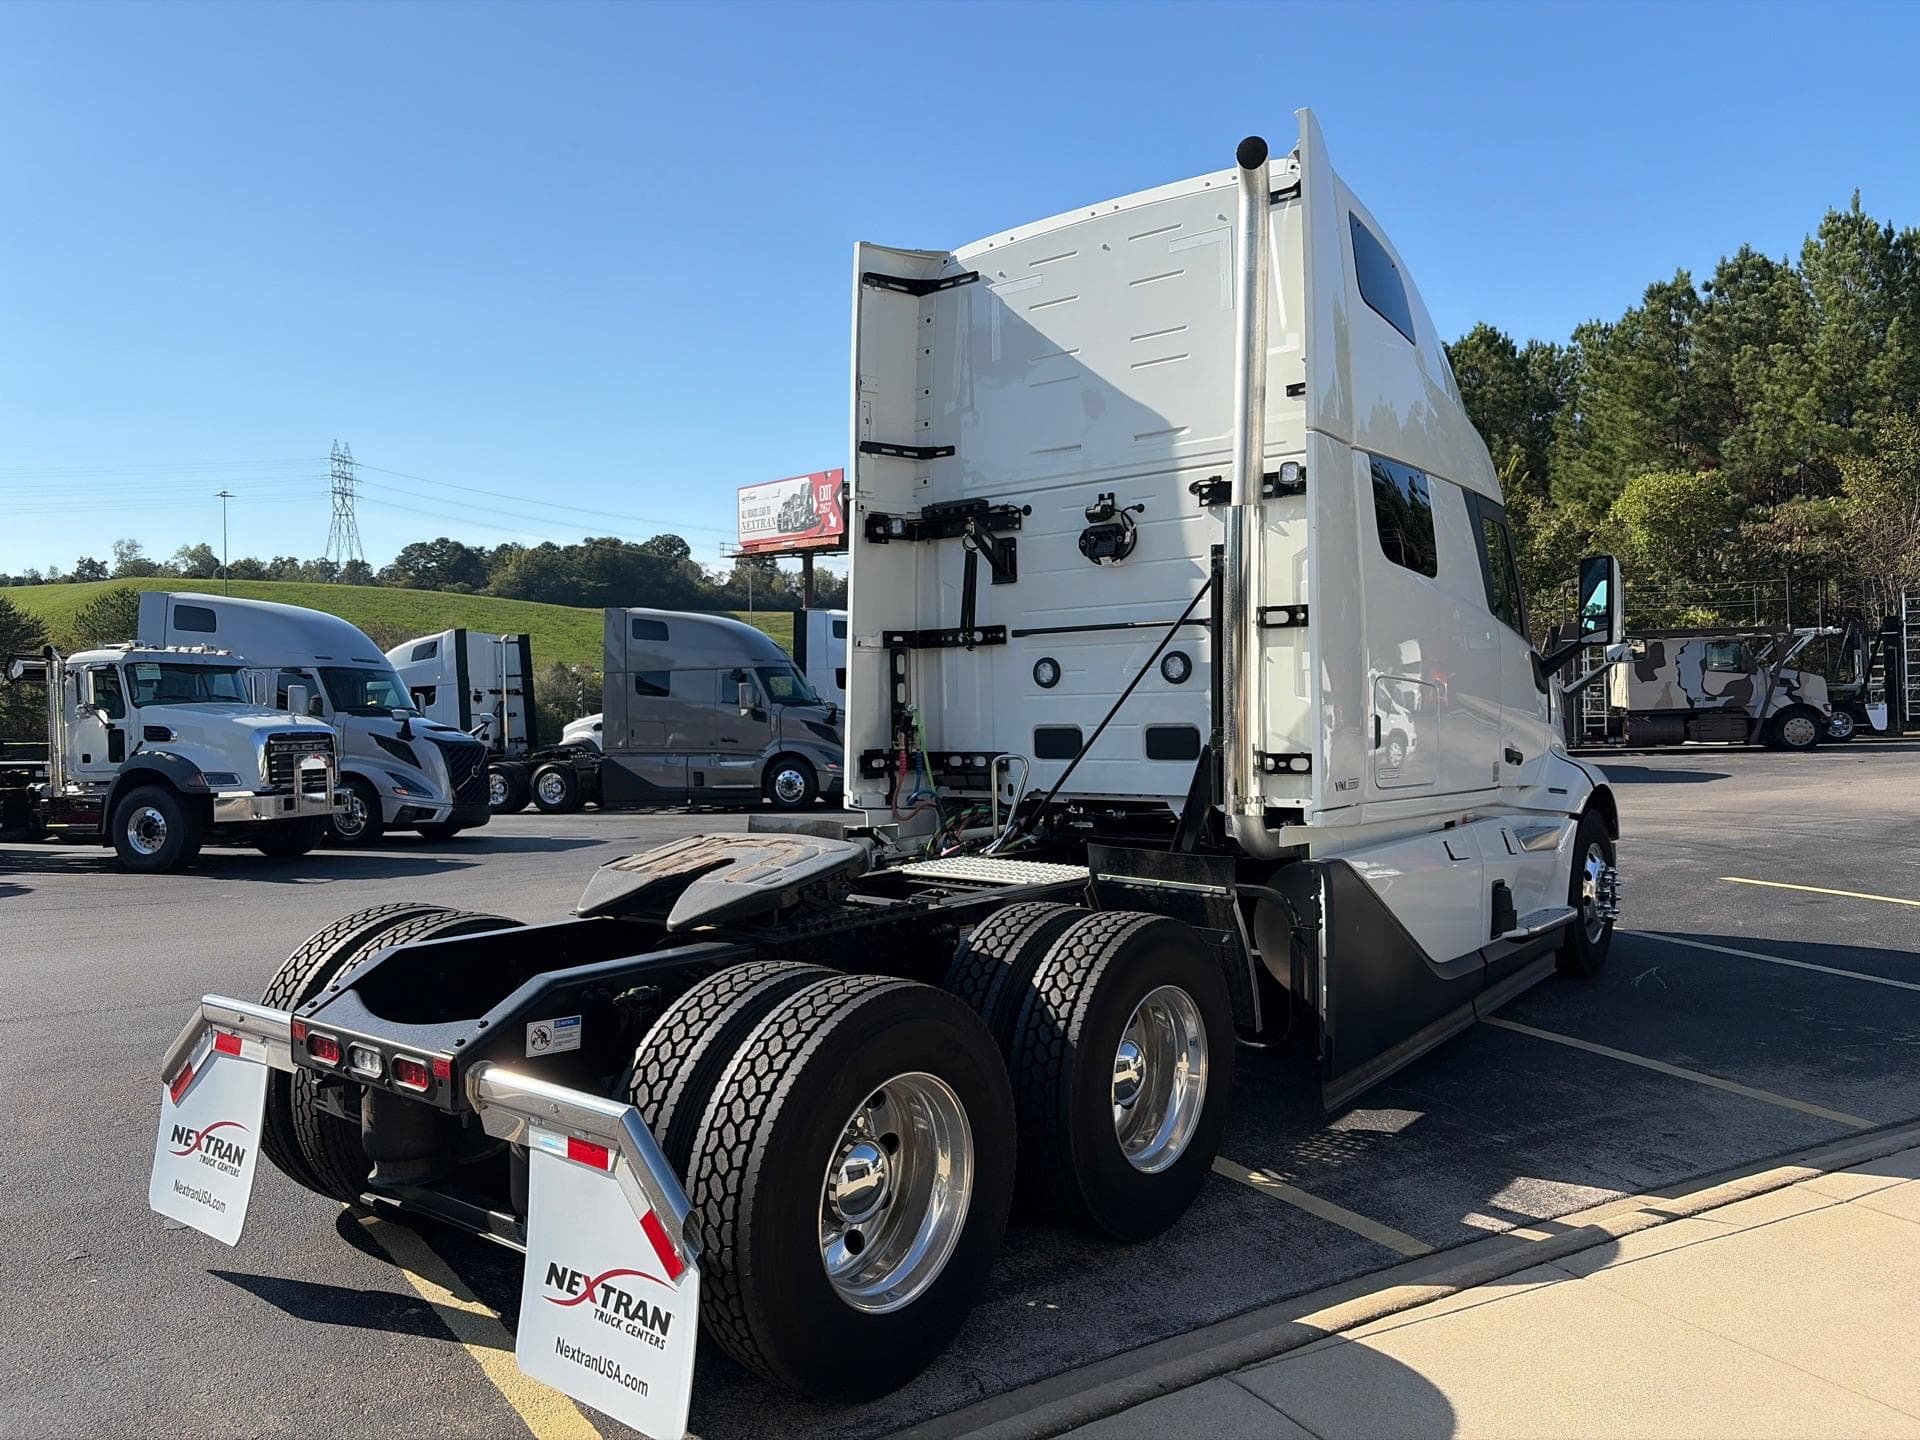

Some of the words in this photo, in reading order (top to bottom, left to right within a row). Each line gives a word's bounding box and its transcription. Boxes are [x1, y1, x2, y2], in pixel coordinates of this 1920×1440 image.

[819, 484, 832, 502] EXIT
[274, 743, 327, 752] MACK
[170, 1123, 247, 1168] NEXTRAN
[199, 1154, 217, 1169] TRUCK
[217, 1161, 241, 1178] CENTERS
[173, 1179, 227, 1214] NextranUSA.com
[544, 1261, 673, 1337] NEXTRAN
[593, 1308, 624, 1331] TRUCK
[625, 1323, 666, 1351] CENTERS
[555, 1336, 649, 1397] NextranUSA.com
